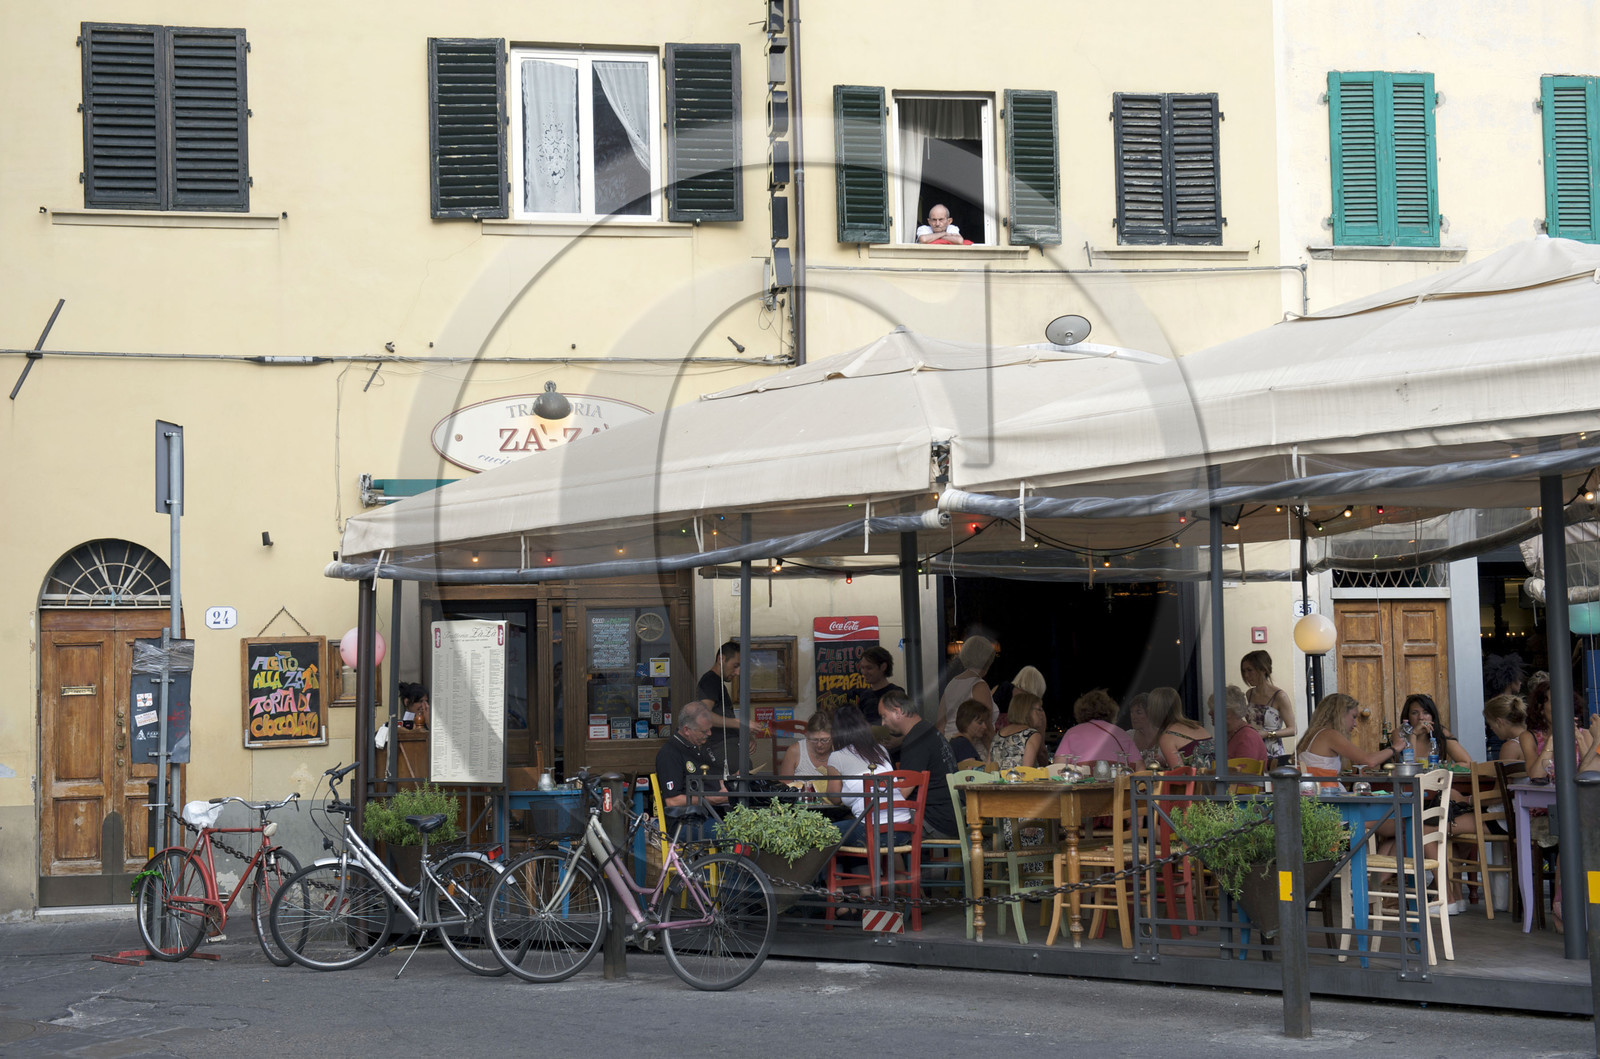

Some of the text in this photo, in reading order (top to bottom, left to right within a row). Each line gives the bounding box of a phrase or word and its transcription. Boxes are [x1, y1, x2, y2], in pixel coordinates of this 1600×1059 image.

[212, 610, 231, 626] 24
[253, 671, 283, 690] ALLA
[249, 687, 312, 716] TORTA DI
